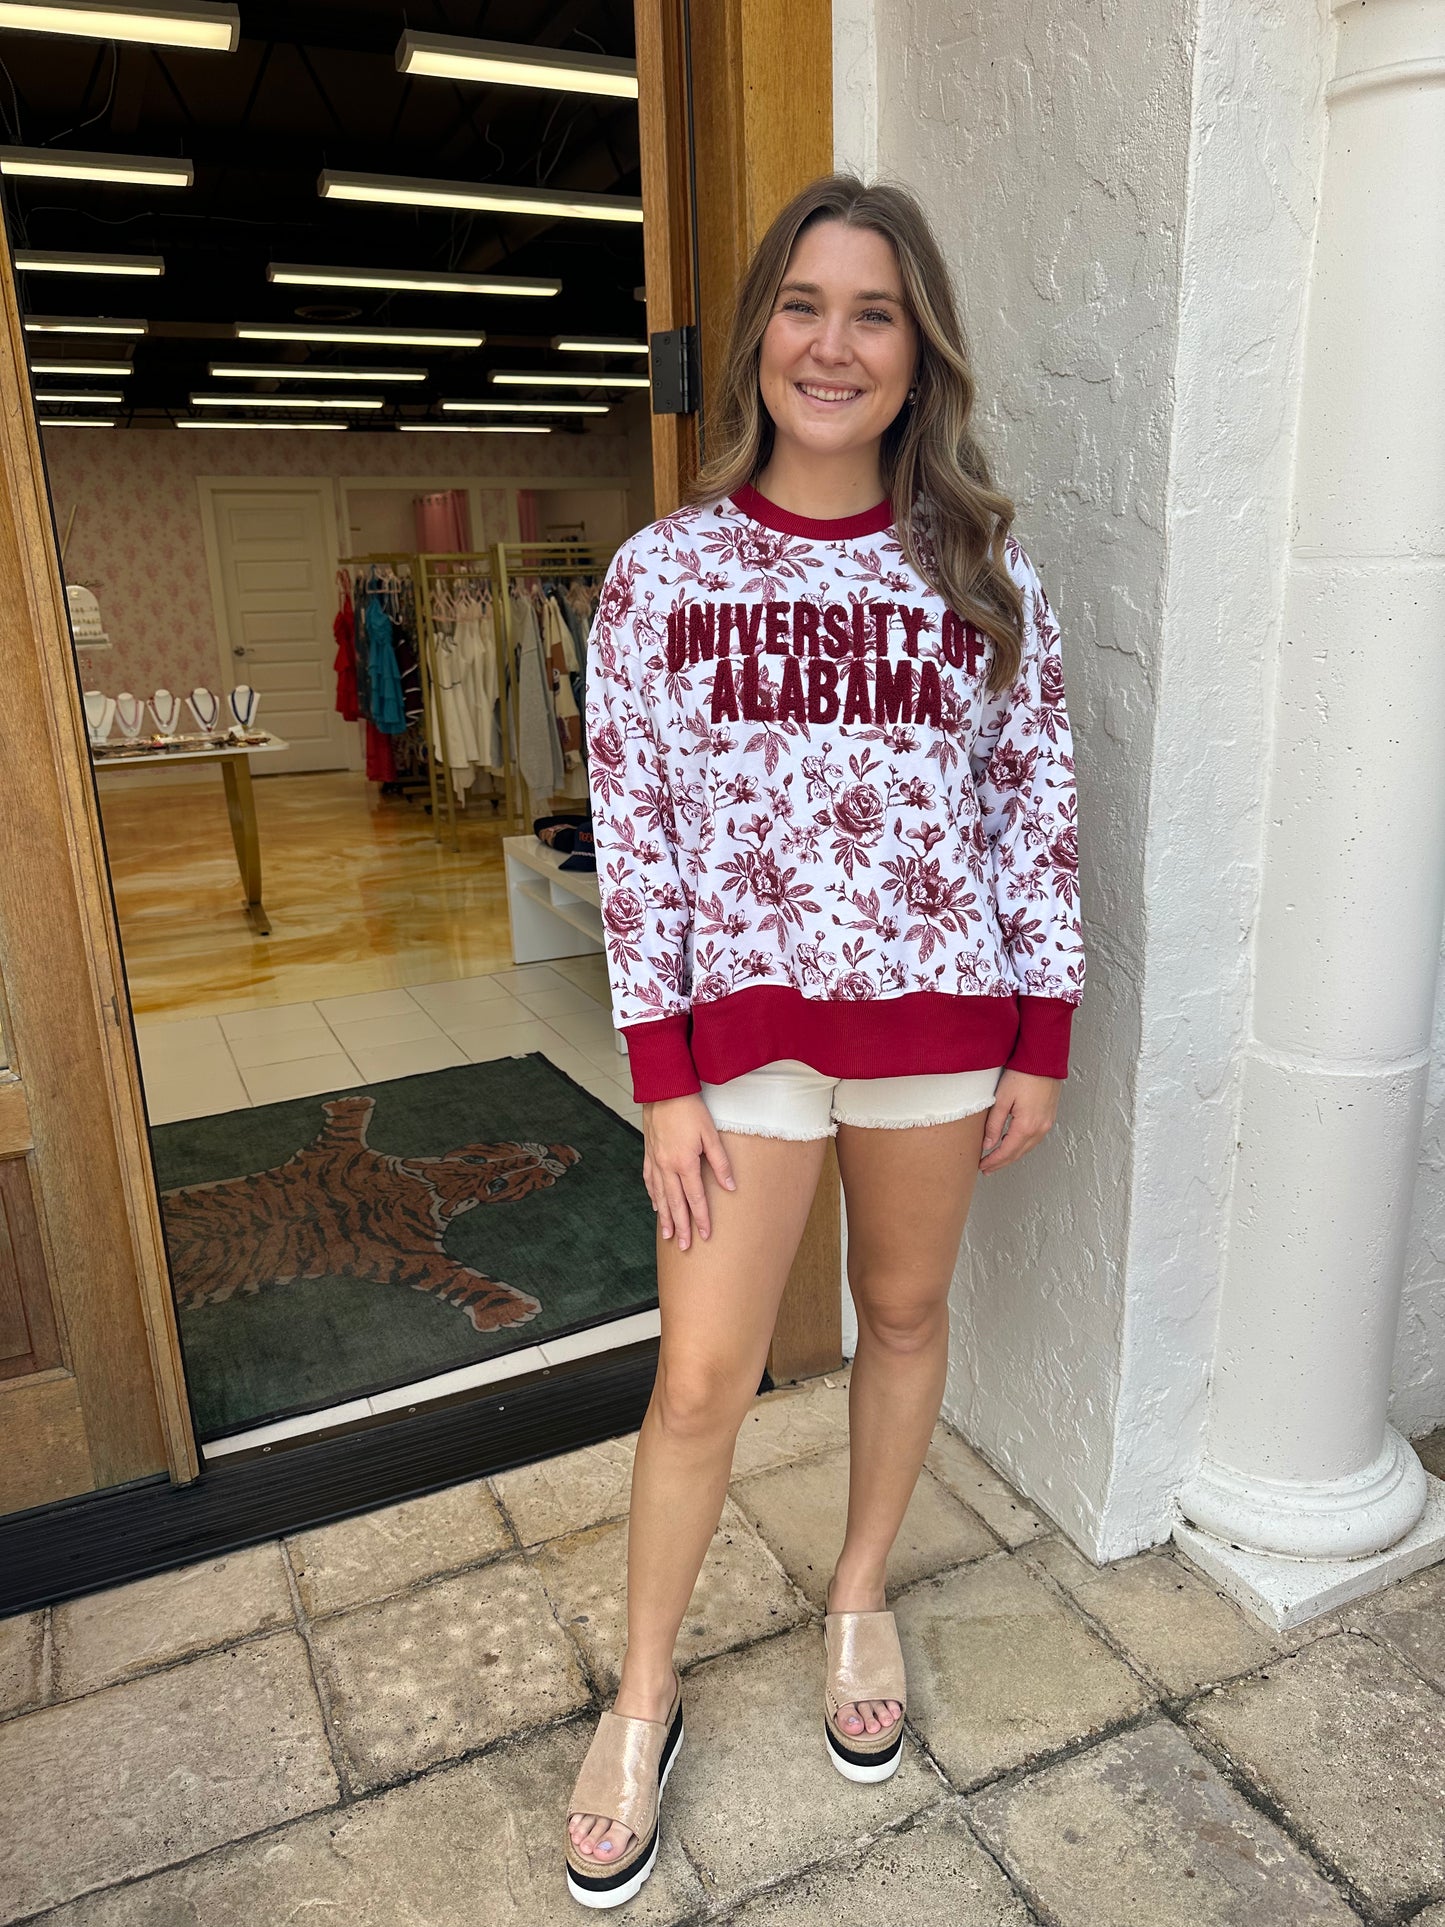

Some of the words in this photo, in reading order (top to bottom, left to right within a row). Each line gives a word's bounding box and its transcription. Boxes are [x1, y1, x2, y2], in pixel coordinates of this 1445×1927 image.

[667, 601, 924, 673] UNIVERSITY
[942, 608, 985, 677] OF
[711, 655, 942, 727] ALABAMA
